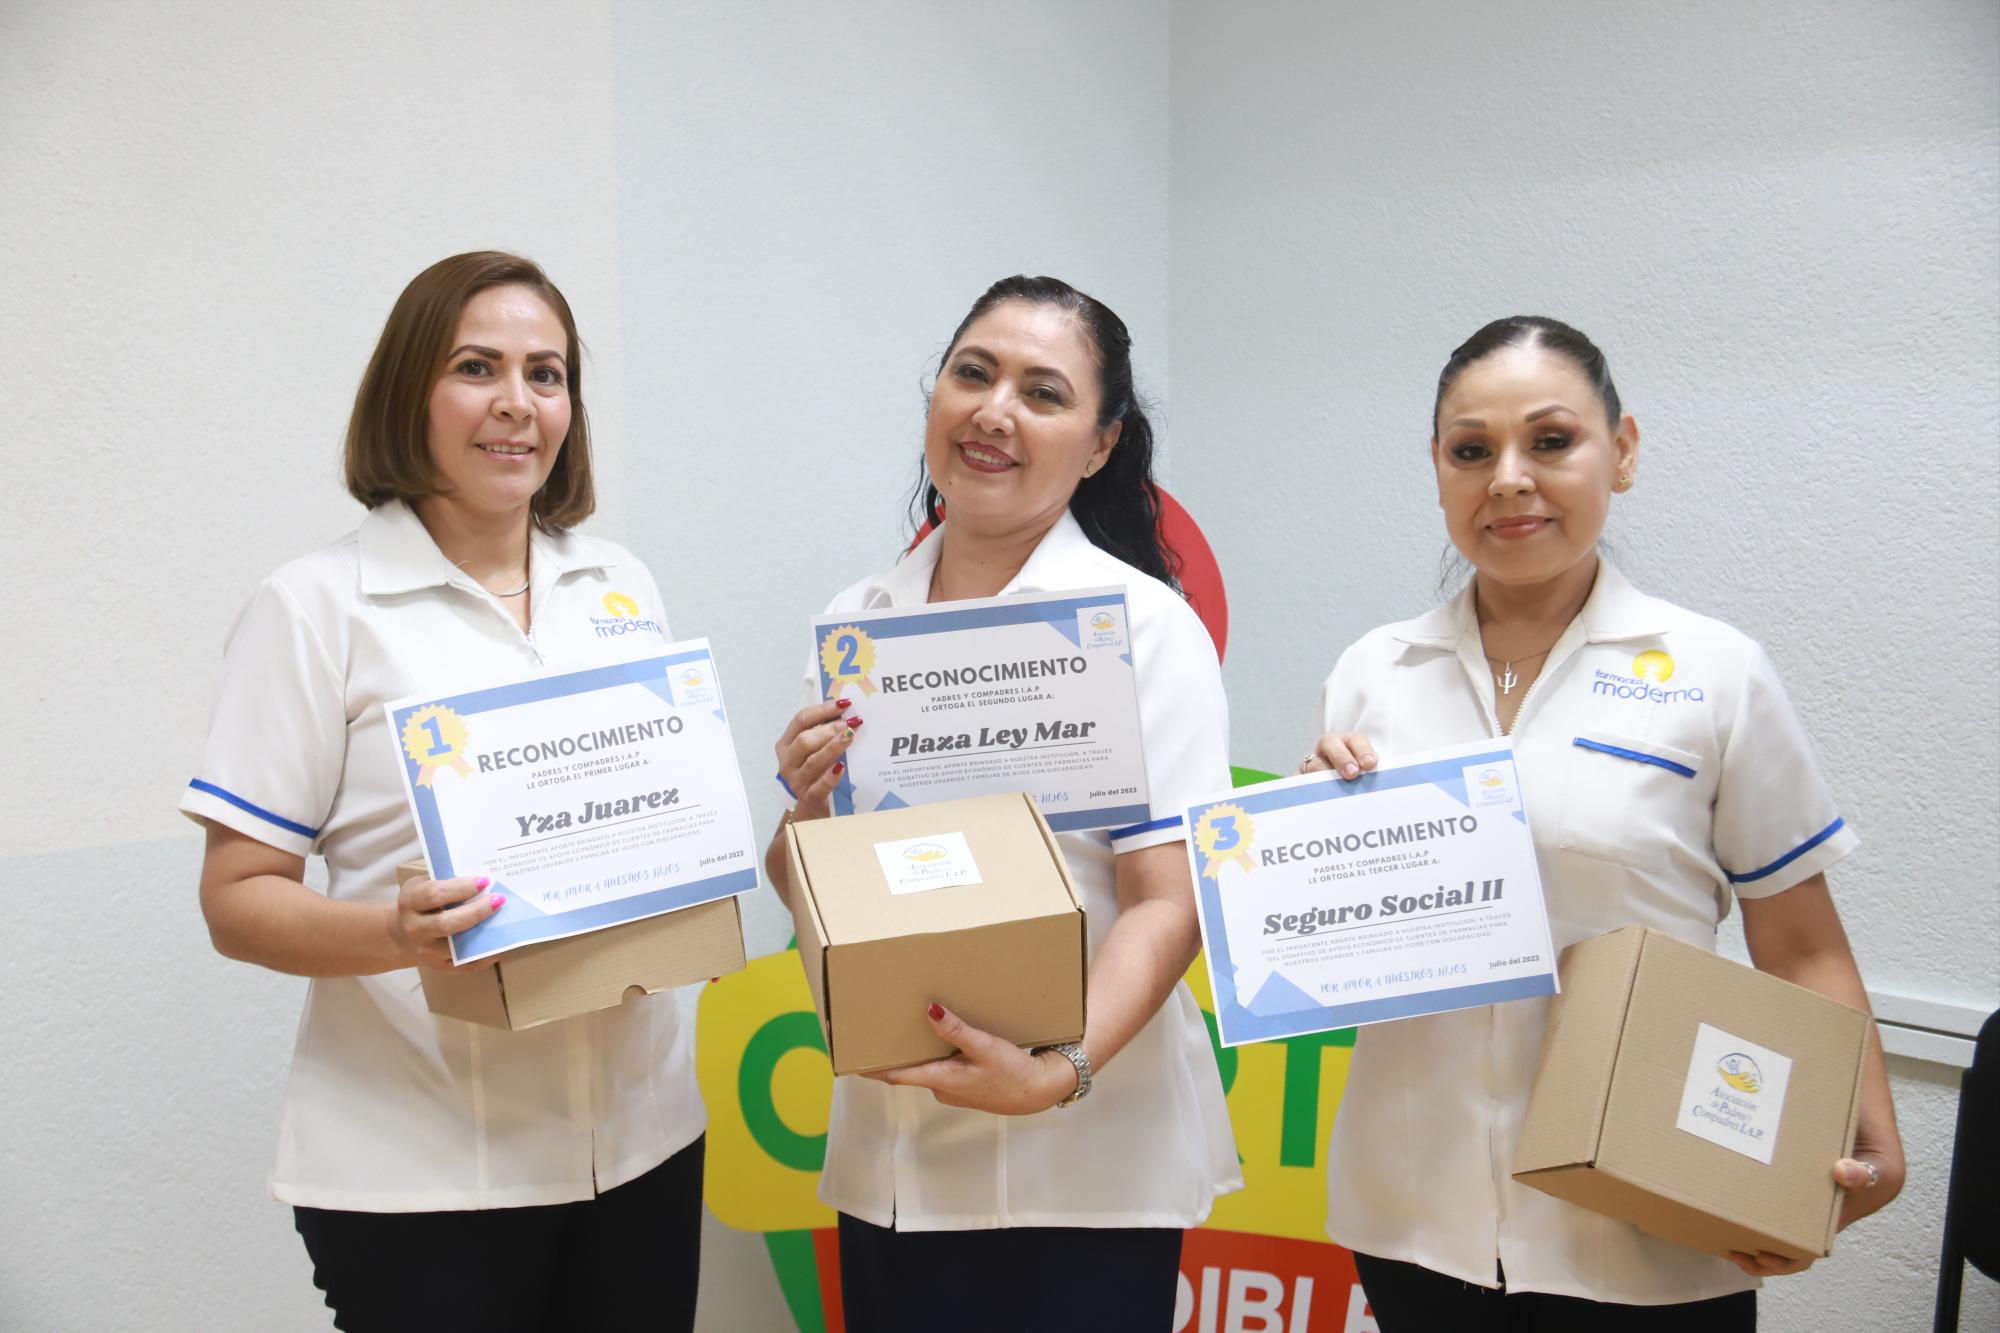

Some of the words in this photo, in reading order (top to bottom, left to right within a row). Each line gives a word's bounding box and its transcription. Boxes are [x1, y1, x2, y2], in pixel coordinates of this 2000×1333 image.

[838, 636, 860, 675] 2
[882, 657, 1086, 693] RECONOCIMIENTO
[1595, 669, 1643, 685] farmacias
[931, 694, 961, 702] PADRES
[971, 688, 1018, 698] COMPADRES
[932, 702, 964, 711] ORTOGA
[978, 697, 1015, 706] SEGUNDO
[1018, 694, 1043, 702] LUGAR
[1592, 681, 1704, 704] moderna
[421, 716, 451, 755] 1
[478, 716, 683, 773] RECONOCIMIENTO
[890, 734, 971, 757] Plaza
[978, 728, 1027, 747] Ley
[1034, 721, 1096, 741] Mar
[531, 767, 562, 779] PADRES
[572, 755, 619, 770] COMPADRES
[537, 775, 571, 787] ORTOGA
[584, 766, 612, 777] PRIMER
[615, 760, 640, 771] LUGAR
[1107, 787, 1118, 796] del
[516, 812, 572, 837] Yza
[578, 788, 679, 824] Juarez
[1211, 816, 1239, 850] 3
[1261, 815, 1477, 866] RECONOCIMIENTO
[716, 853, 727, 862] del
[728, 849, 744, 859] 2023
[1313, 863, 1345, 874] PADRES
[1356, 853, 1406, 867] COMPADRES
[564, 882, 590, 897] AMOR
[603, 868, 649, 888] NUESTROS
[652, 861, 680, 877] HIJOS
[1319, 871, 1354, 882] ORTOGA
[1368, 864, 1398, 874] TERCER
[1401, 859, 1428, 869] LUGAR
[1263, 904, 1372, 936] Seguro
[1380, 881, 1474, 917] Social
[1481, 879, 1504, 901] II
[1508, 956, 1520, 966] del
[1521, 953, 1539, 964] 2023
[1320, 982, 1338, 994] POR
[1342, 977, 1372, 991] AMOR
[1384, 967, 1433, 984] NUESTROS
[1437, 962, 1467, 976] HIJOS
